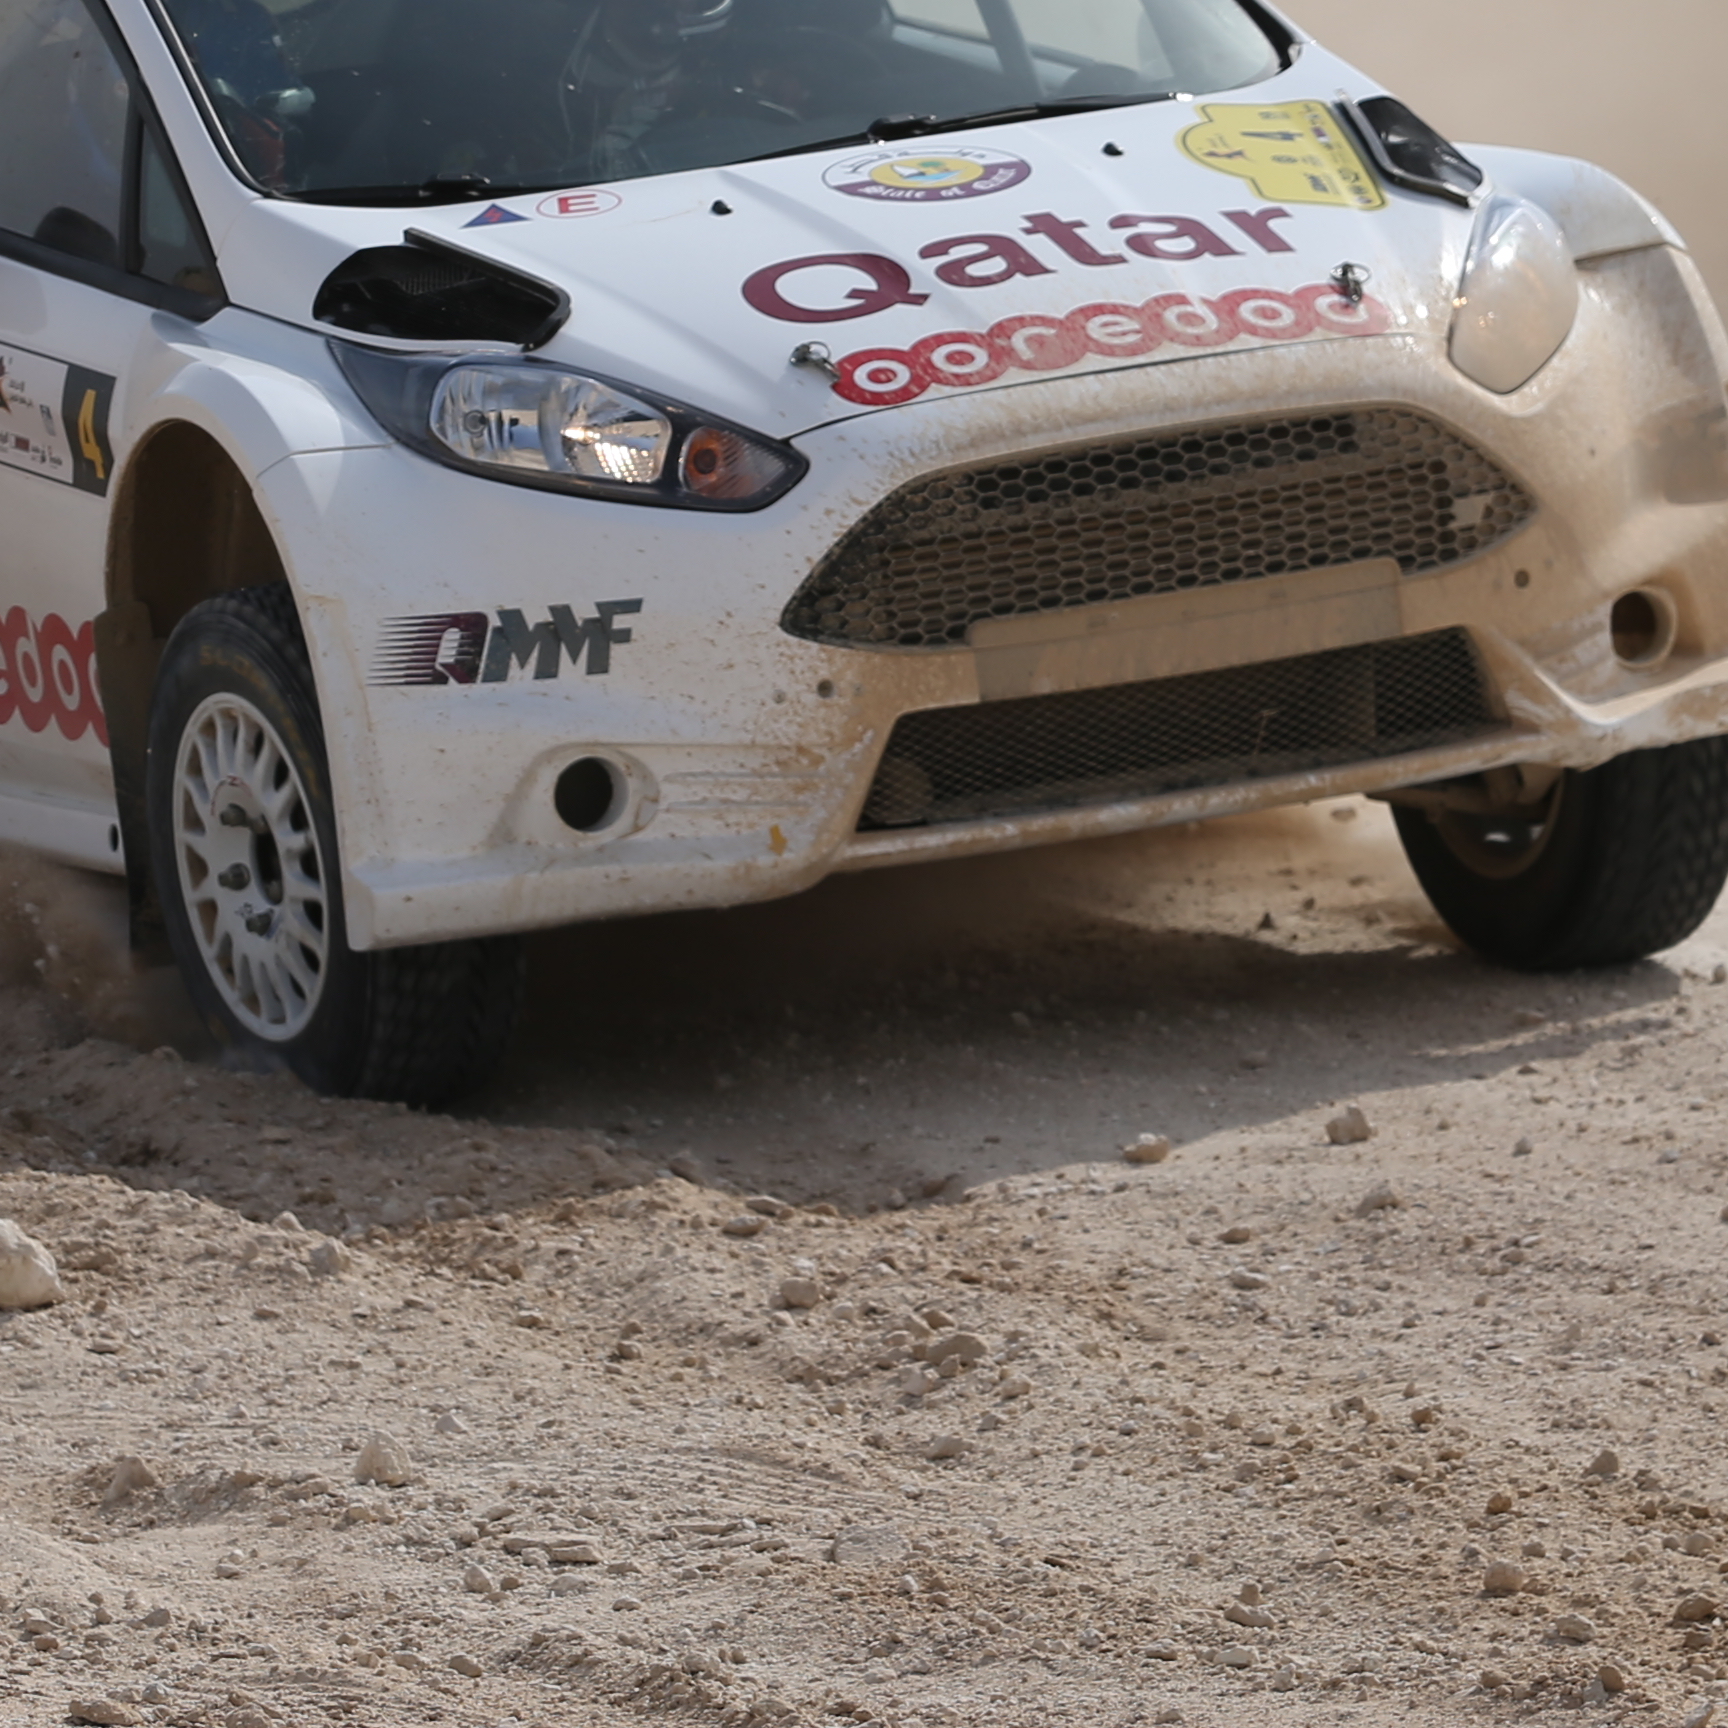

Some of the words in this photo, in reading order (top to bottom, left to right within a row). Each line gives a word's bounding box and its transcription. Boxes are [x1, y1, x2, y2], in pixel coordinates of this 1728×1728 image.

[557, 193, 600, 215] E
[742, 206, 1297, 323] Qatar
[850, 289, 1373, 394] ooredoo
[77, 388, 106, 480] 4
[367, 597, 644, 686] QMMF
